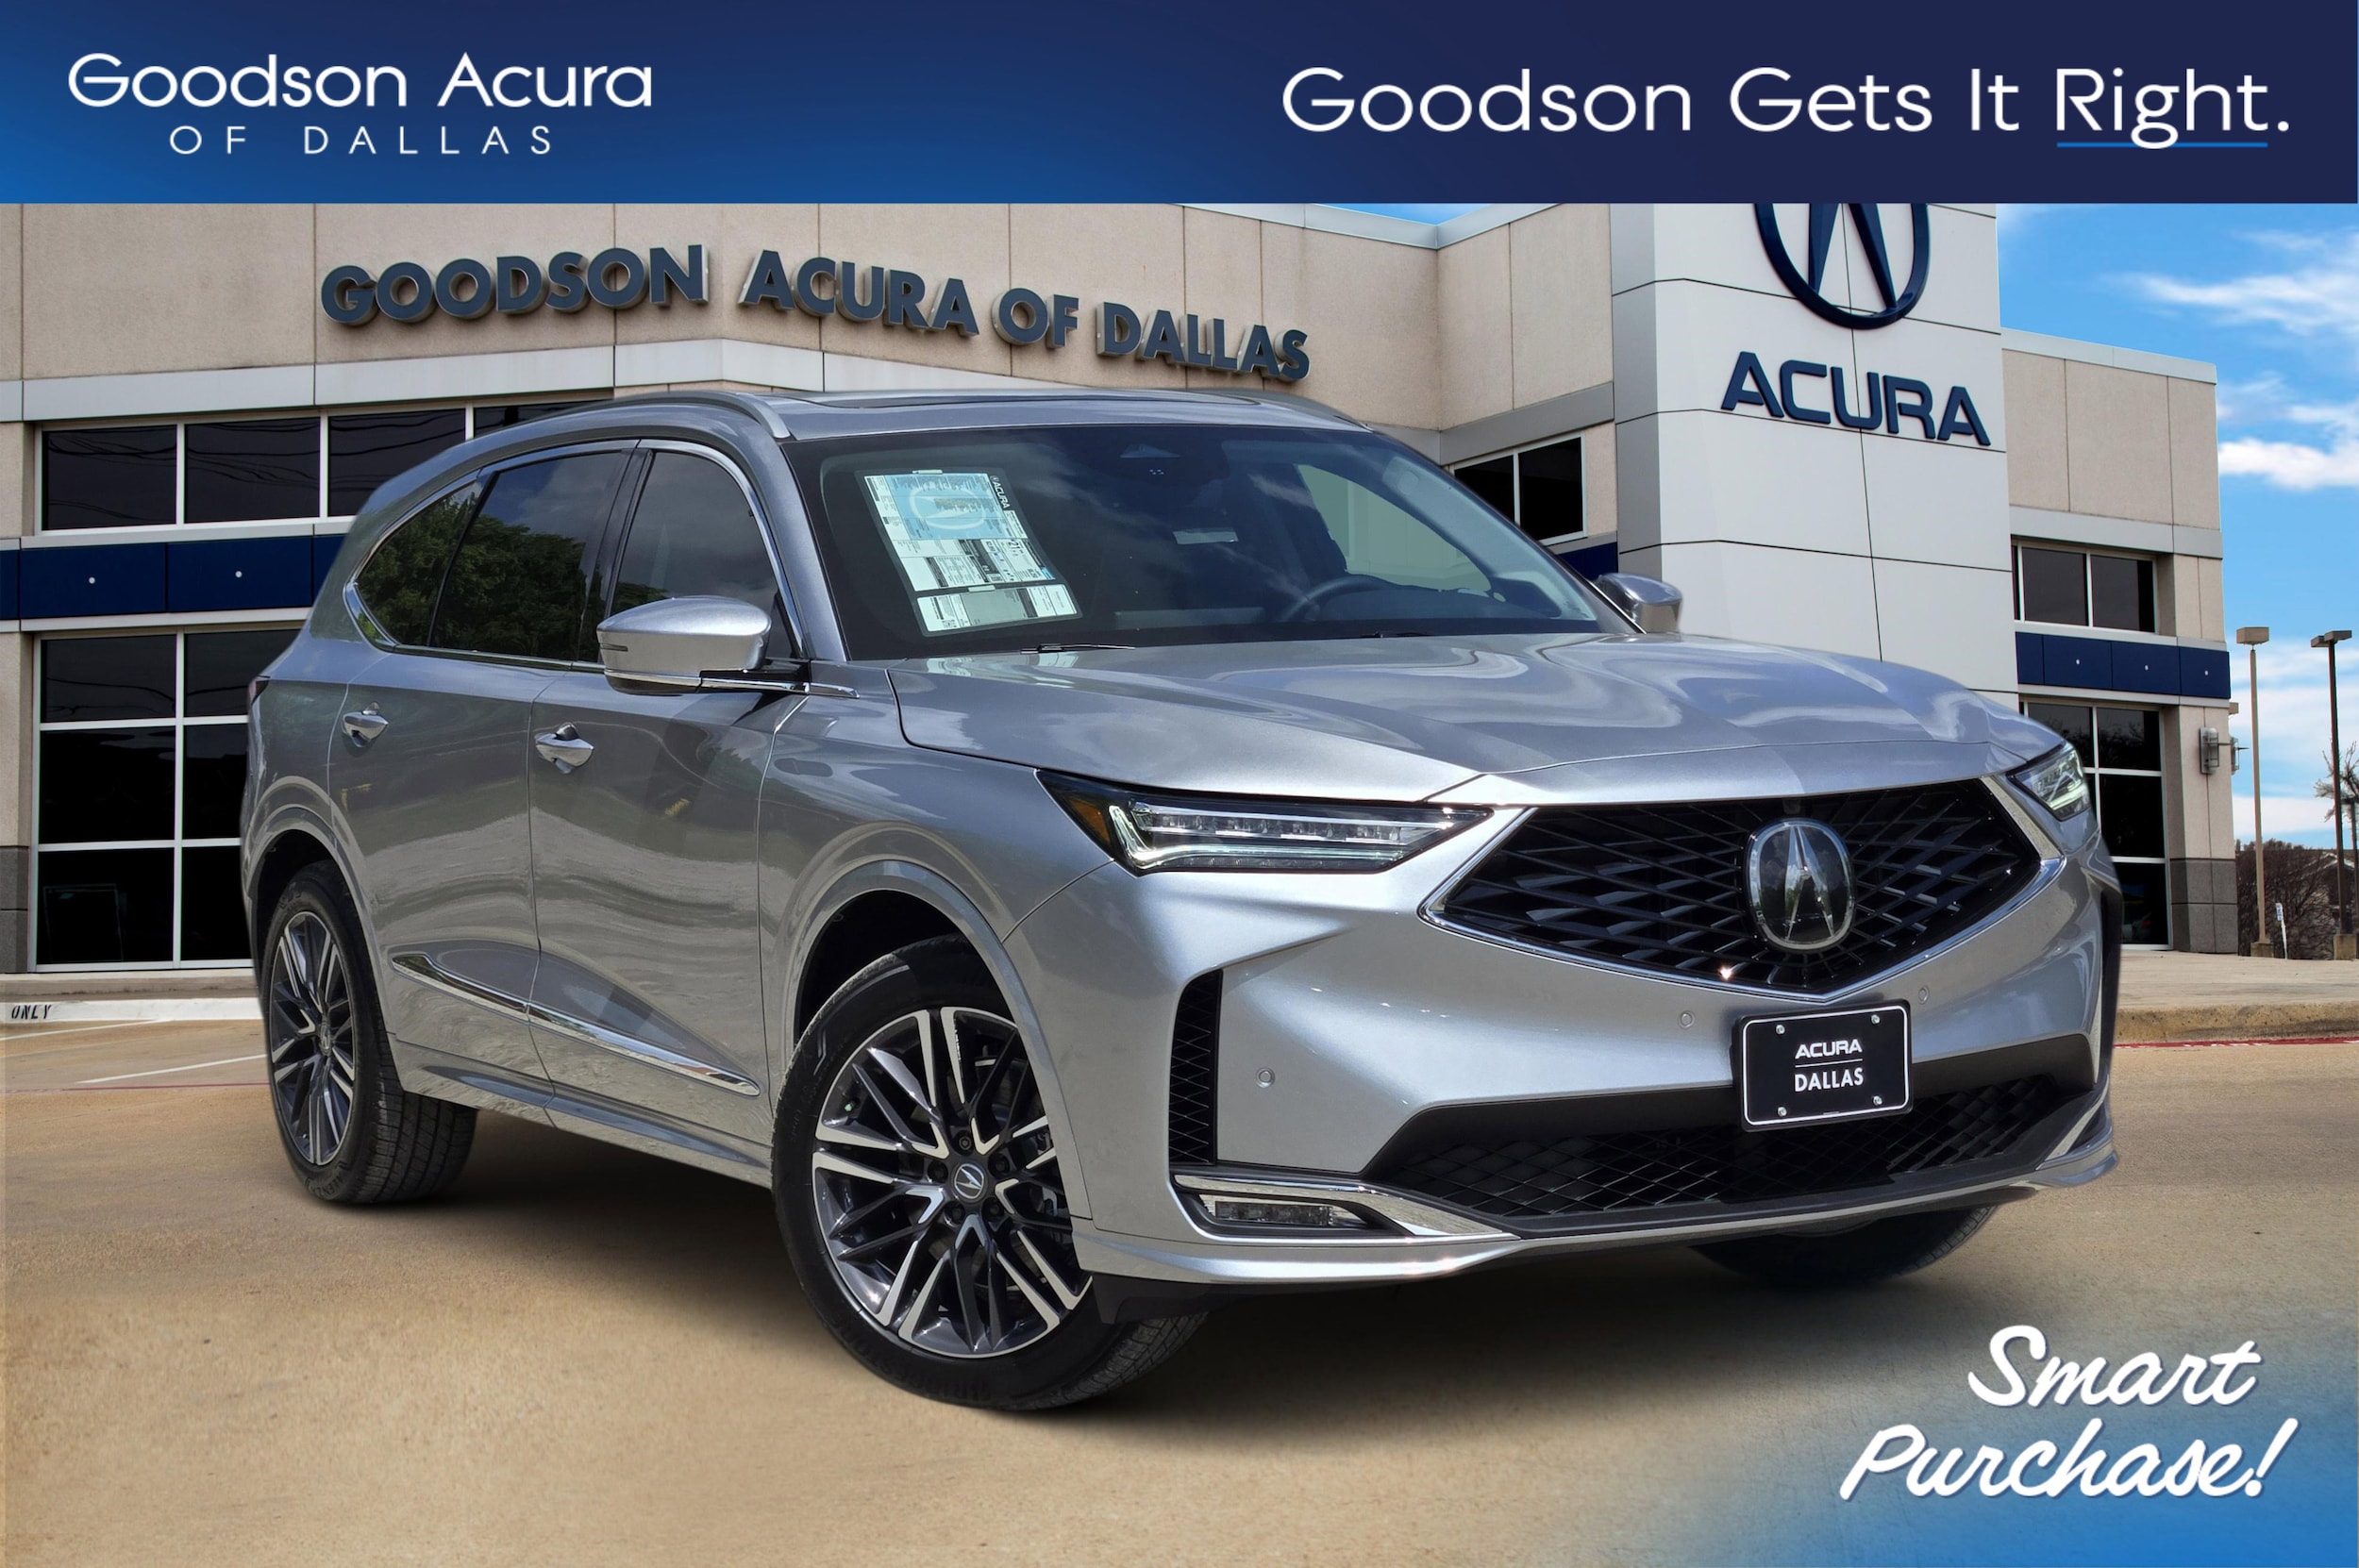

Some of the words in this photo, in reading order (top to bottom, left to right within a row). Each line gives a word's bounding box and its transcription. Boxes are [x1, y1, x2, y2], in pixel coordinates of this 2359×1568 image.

[321, 243, 710, 326] GOODSON
[738, 249, 980, 337] ACURA
[992, 288, 1079, 350] OF
[1096, 301, 1311, 382] DALLAS
[1720, 351, 1992, 447] ACURA
[992, 481, 1011, 509] ACURA
[11, 1005, 52, 1020] ONLY
[1795, 1038, 1863, 1059] ACURA
[1794, 1066, 1865, 1093] DALLAS
